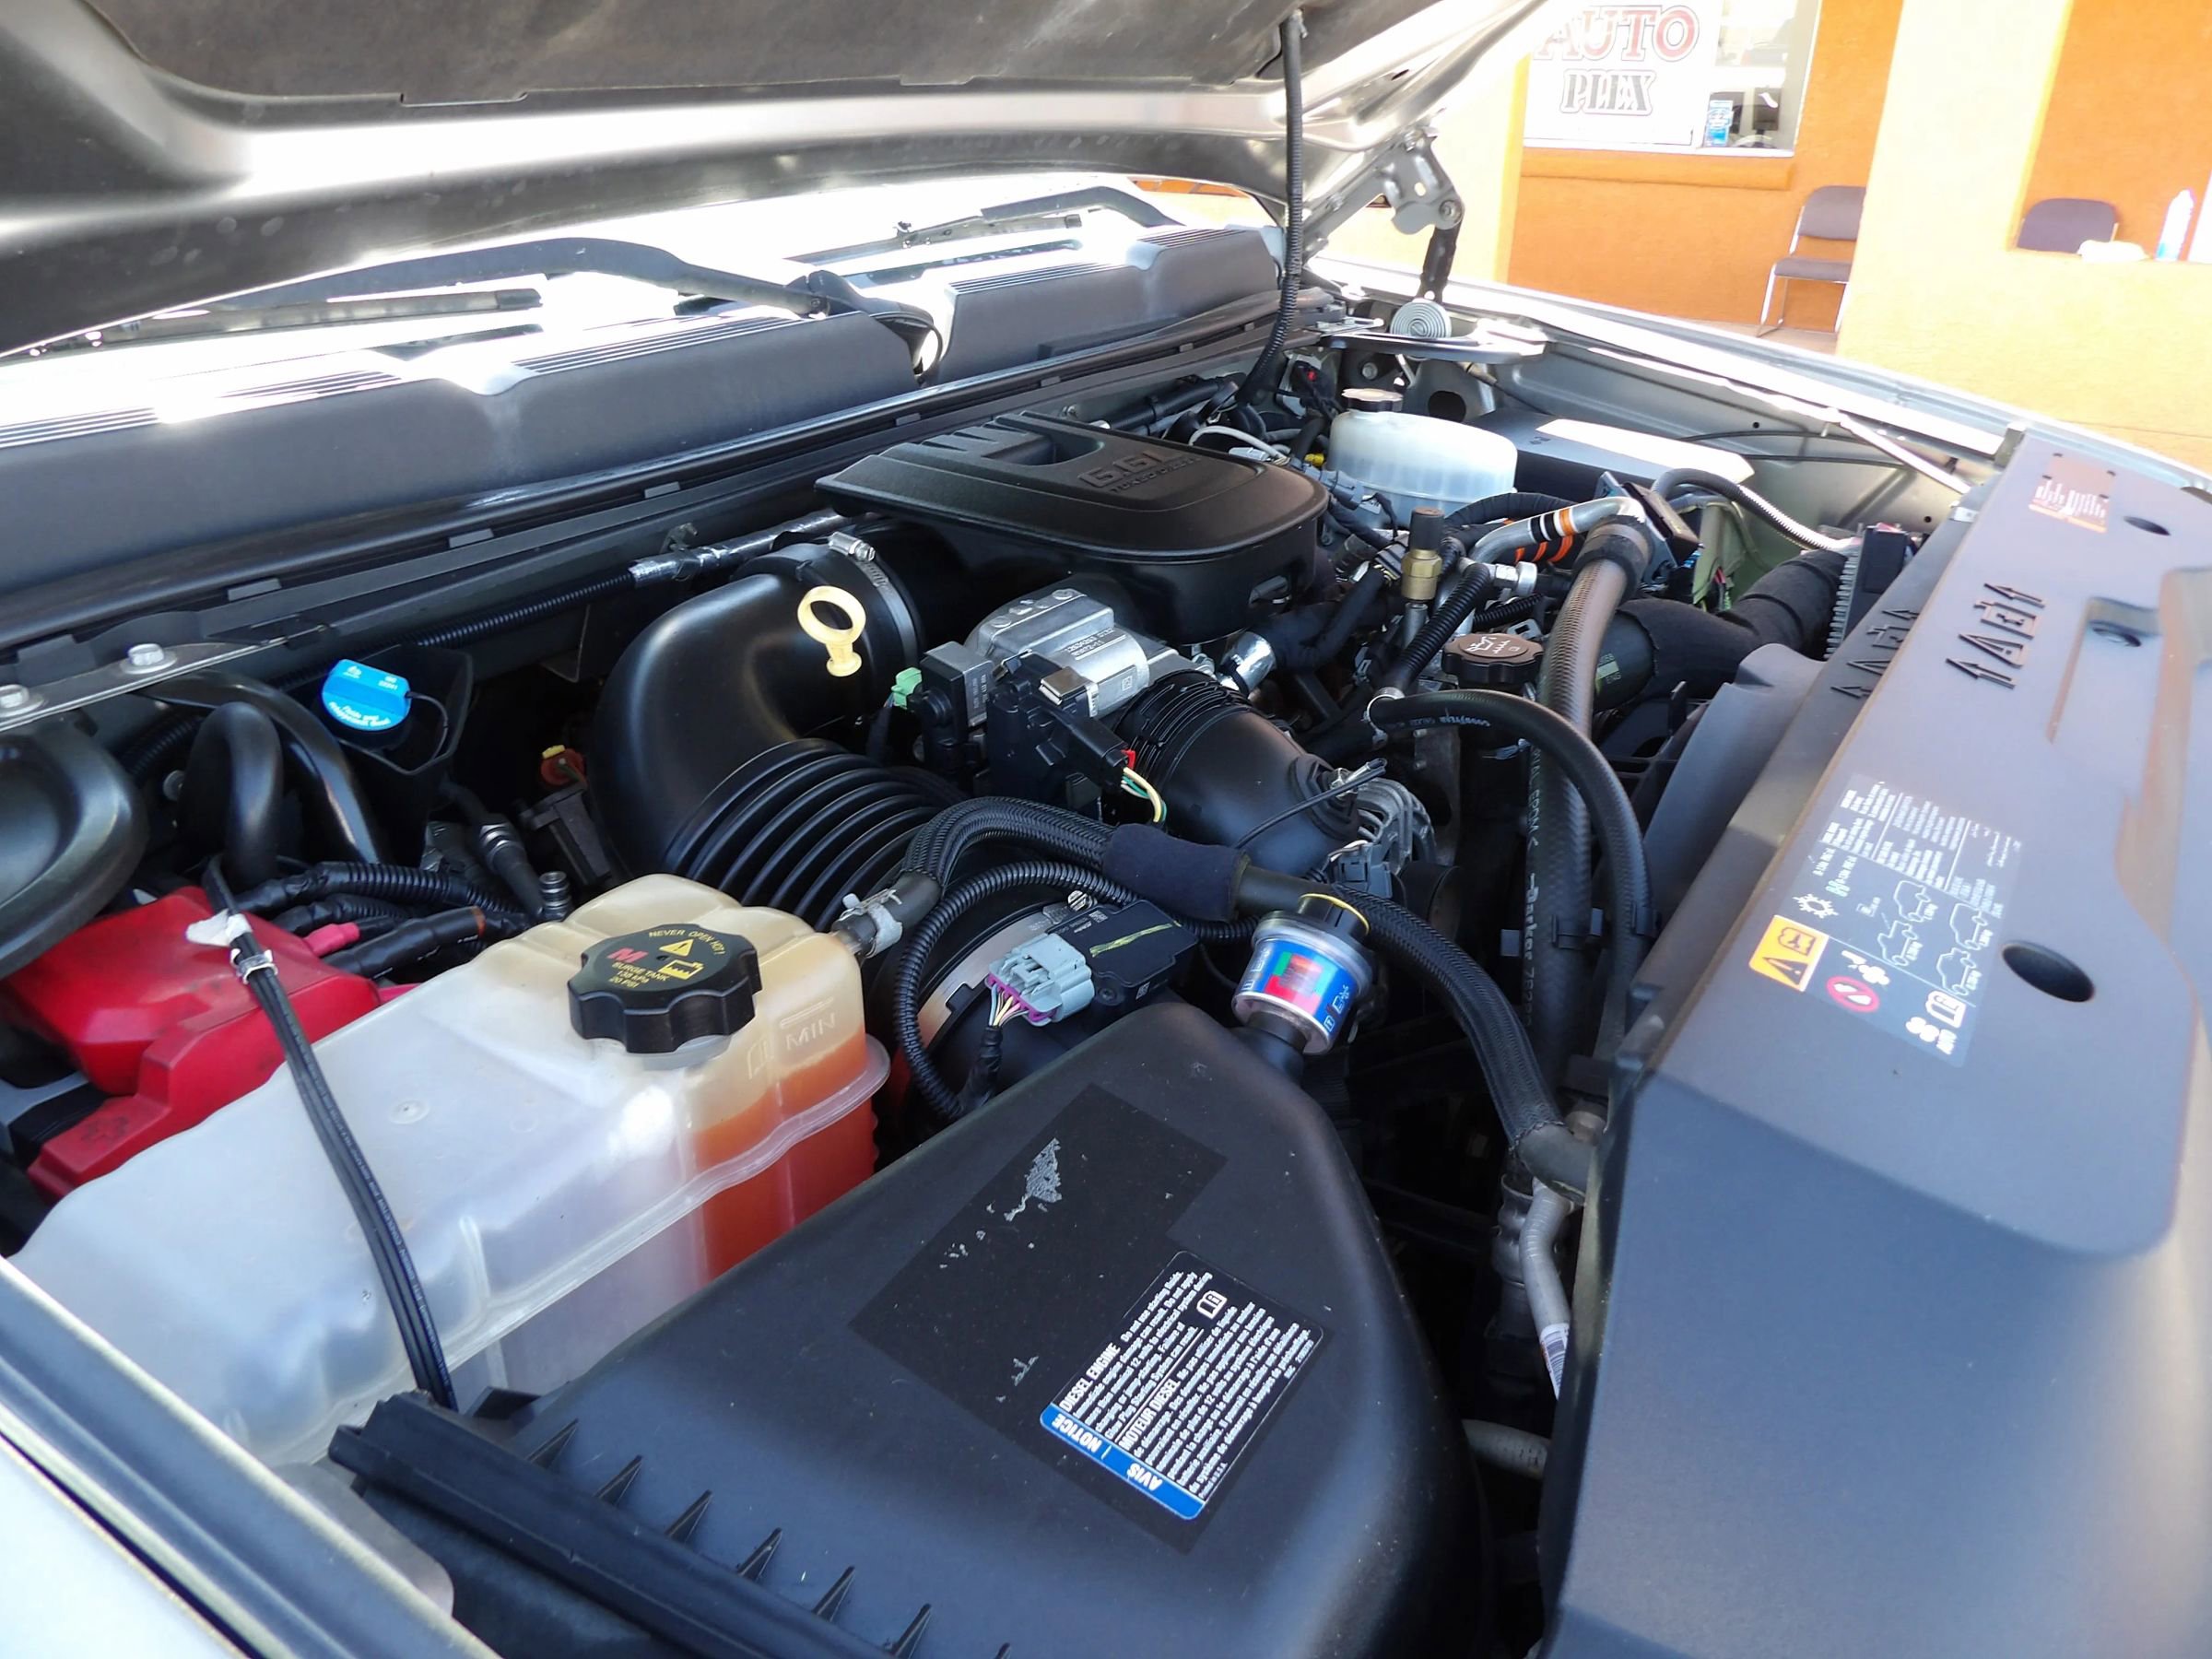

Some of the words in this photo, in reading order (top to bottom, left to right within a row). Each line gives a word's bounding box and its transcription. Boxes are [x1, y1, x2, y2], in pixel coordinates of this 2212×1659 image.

[1534, 5, 1700, 62] AUTO
[1559, 68, 1656, 116] PLEX
[649, 929, 685, 937] NEVER
[688, 931, 712, 943] OPEN
[785, 1012, 836, 1052] MIN
[1060, 1379, 1093, 1412] DIESEL
[1086, 1343, 1120, 1380] ENGINE
[1053, 1414, 1101, 1452] NOTICE
[1119, 1407, 1156, 1450] MOTEUR
[1149, 1376, 1181, 1411] DIESEL
[1127, 1464, 1162, 1489] AVIS
